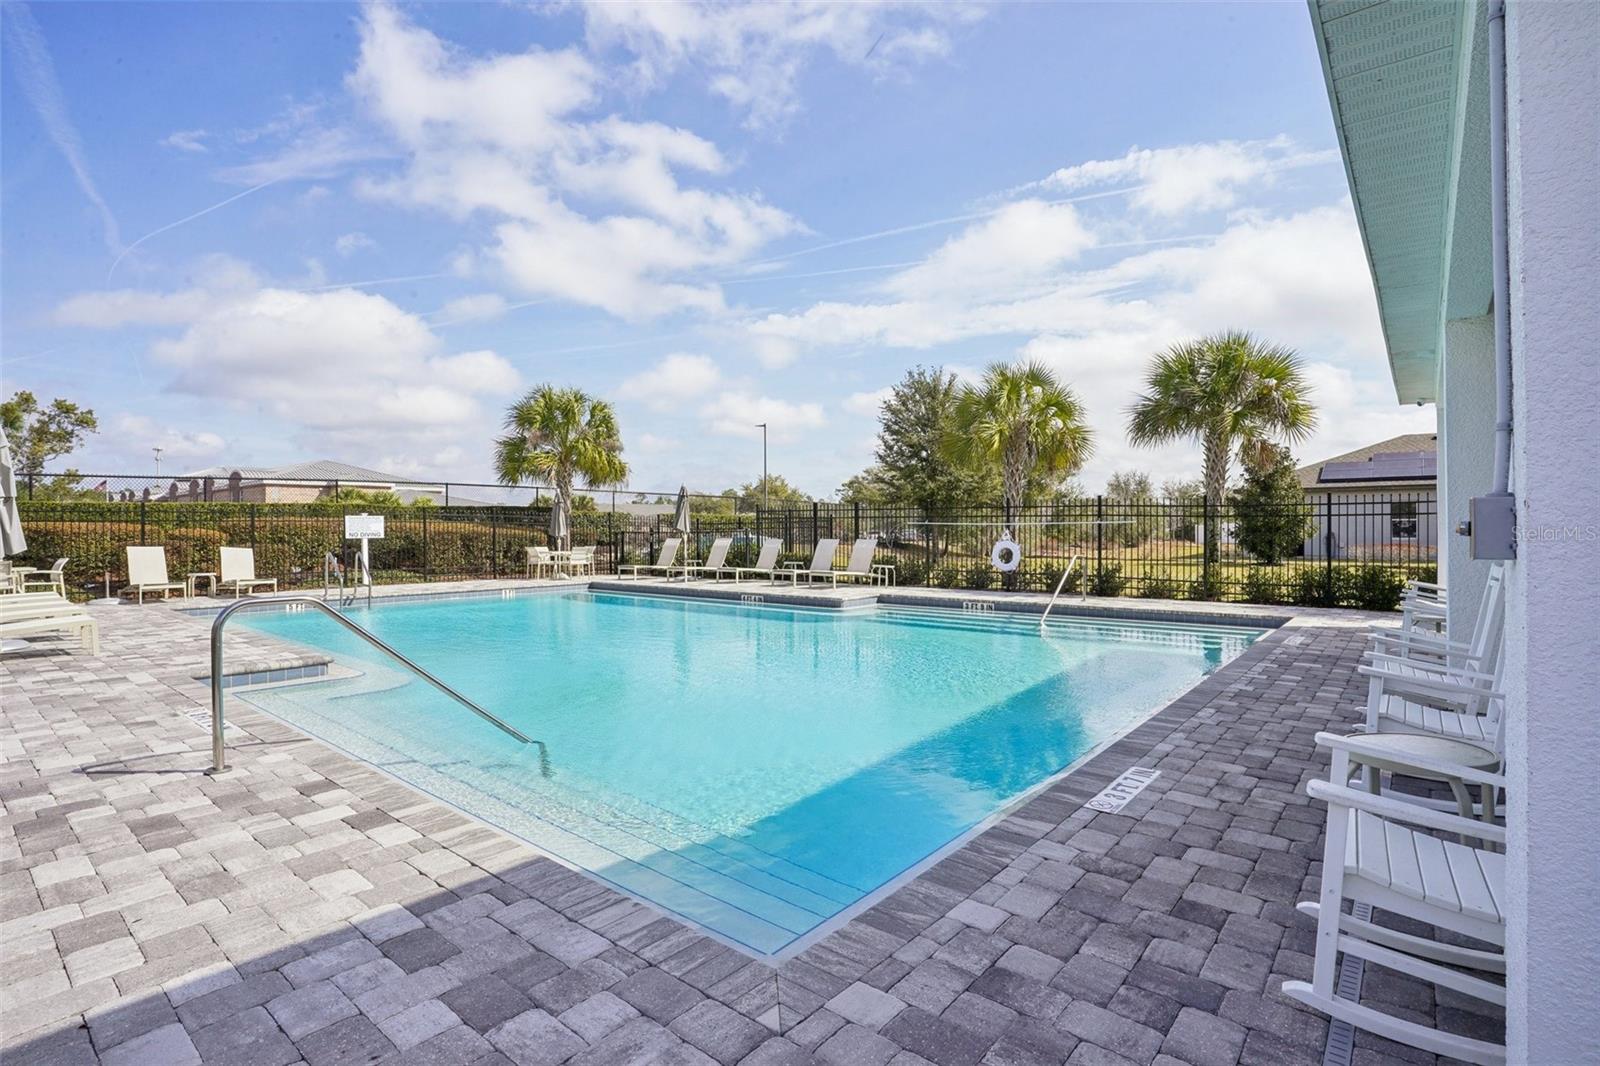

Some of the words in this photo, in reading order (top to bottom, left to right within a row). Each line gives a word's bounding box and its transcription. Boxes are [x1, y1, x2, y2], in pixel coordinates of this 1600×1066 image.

[1130, 768, 1156, 778] IN
[1122, 776, 1145, 784] 7
[1111, 783, 1139, 794] FT
